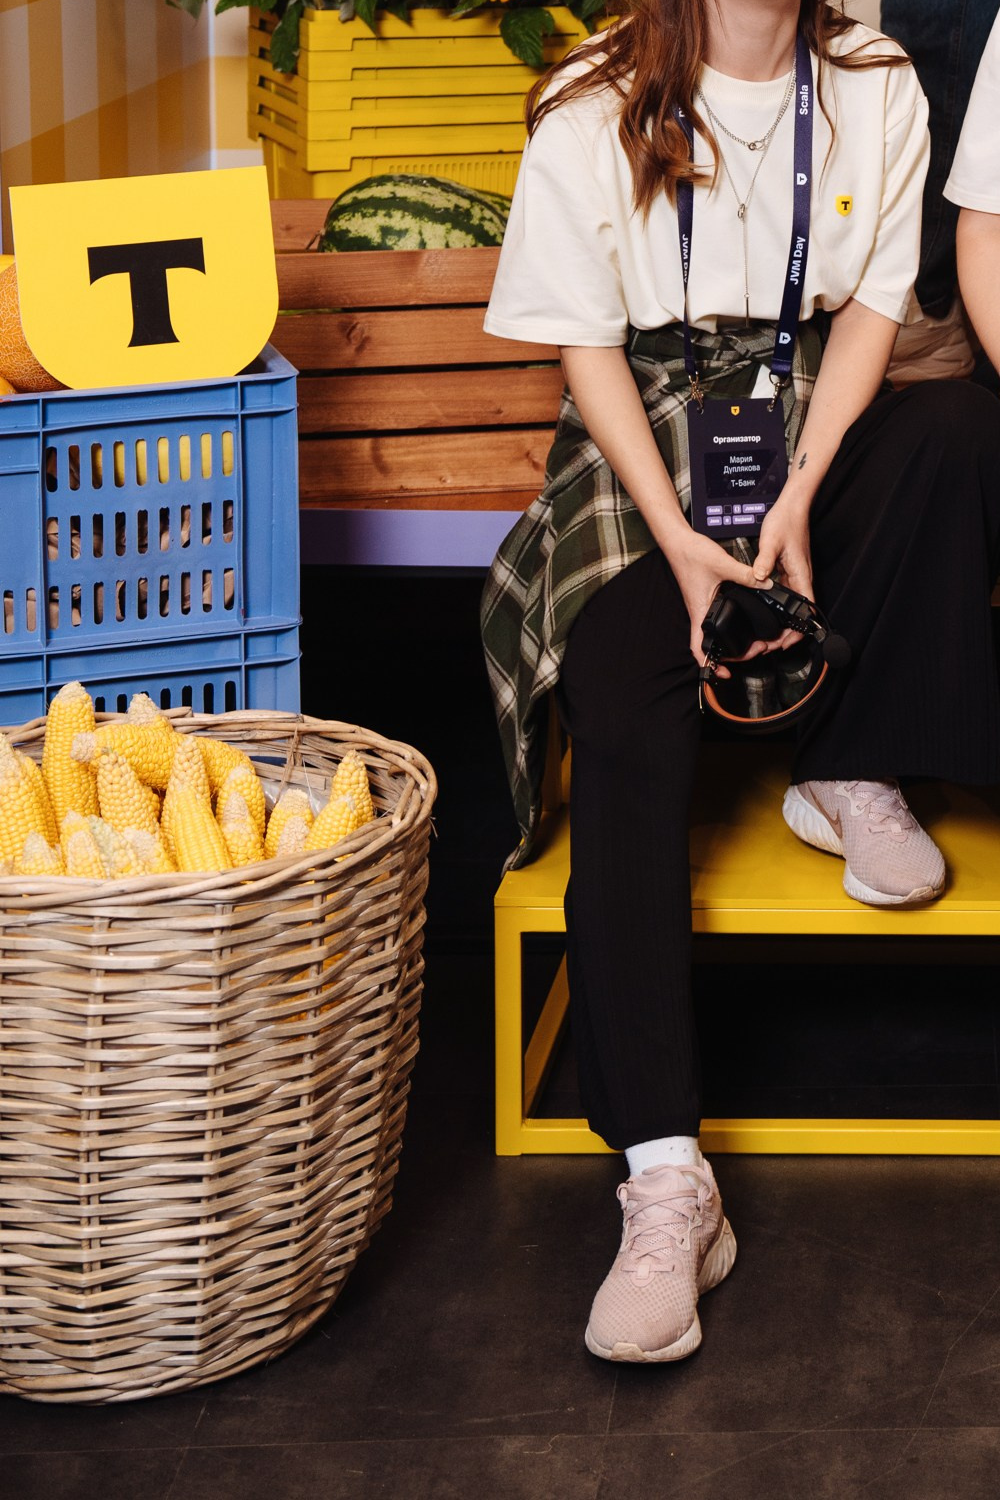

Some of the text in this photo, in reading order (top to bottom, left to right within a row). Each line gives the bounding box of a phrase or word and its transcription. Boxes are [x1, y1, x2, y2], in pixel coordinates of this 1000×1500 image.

[799, 84, 809, 115] Scala
[790, 235, 806, 286] JVM Day
[86, 236, 207, 348] T
[713, 435, 761, 444] Организатор
[723, 465, 760, 474] Дуплякова
[730, 456, 753, 464] Мария
